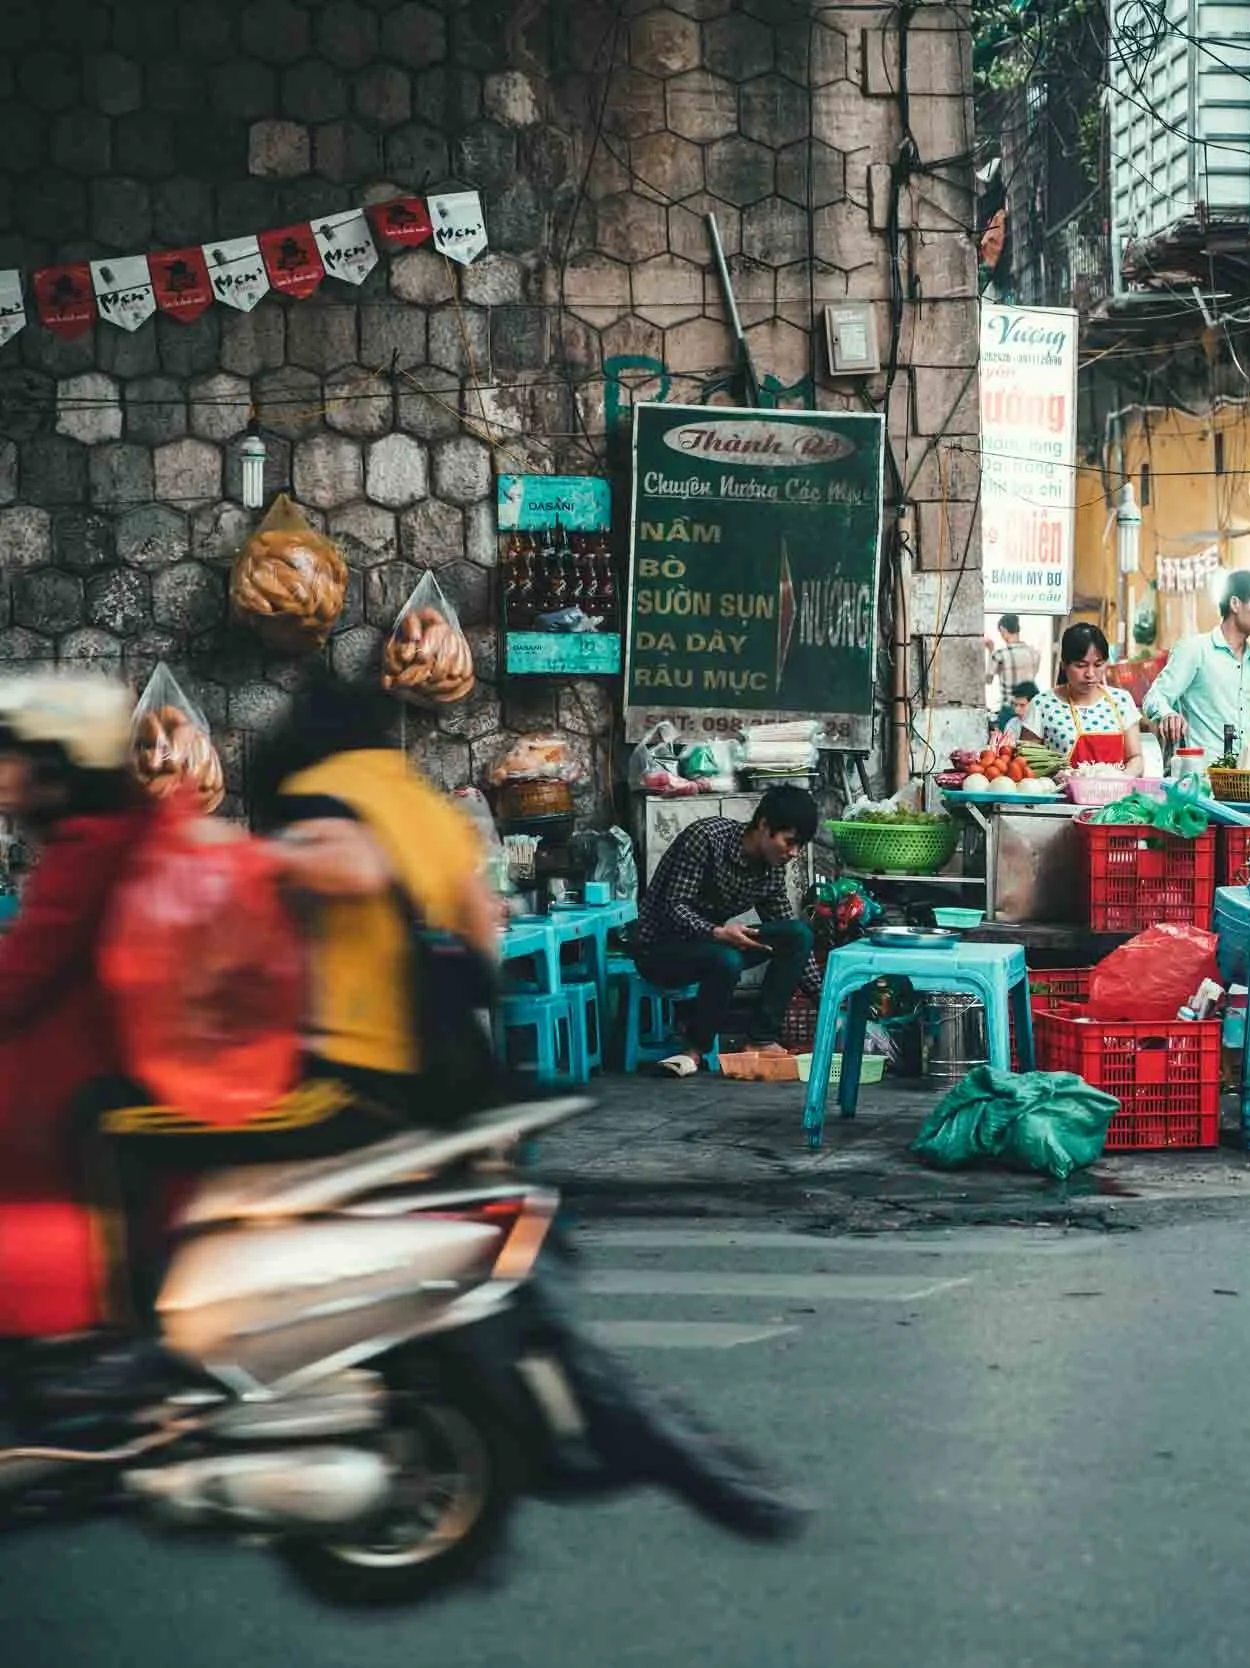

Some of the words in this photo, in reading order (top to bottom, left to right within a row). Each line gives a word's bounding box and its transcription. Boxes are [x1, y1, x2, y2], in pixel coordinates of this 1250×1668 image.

[984, 386, 1065, 432] ướng
[678, 429, 782, 454] Thành
[643, 471, 712, 499] Chuyên
[528, 501, 574, 512] DASANI
[640, 515, 721, 543] NẦM
[639, 554, 687, 578] BÒ
[637, 583, 711, 616] SƯỜN
[719, 593, 774, 627] SỤN
[799, 562, 871, 649] NƯỚNG
[635, 631, 677, 656] DẠ
[634, 663, 693, 688] RÂU
[703, 668, 769, 695] MỰC
